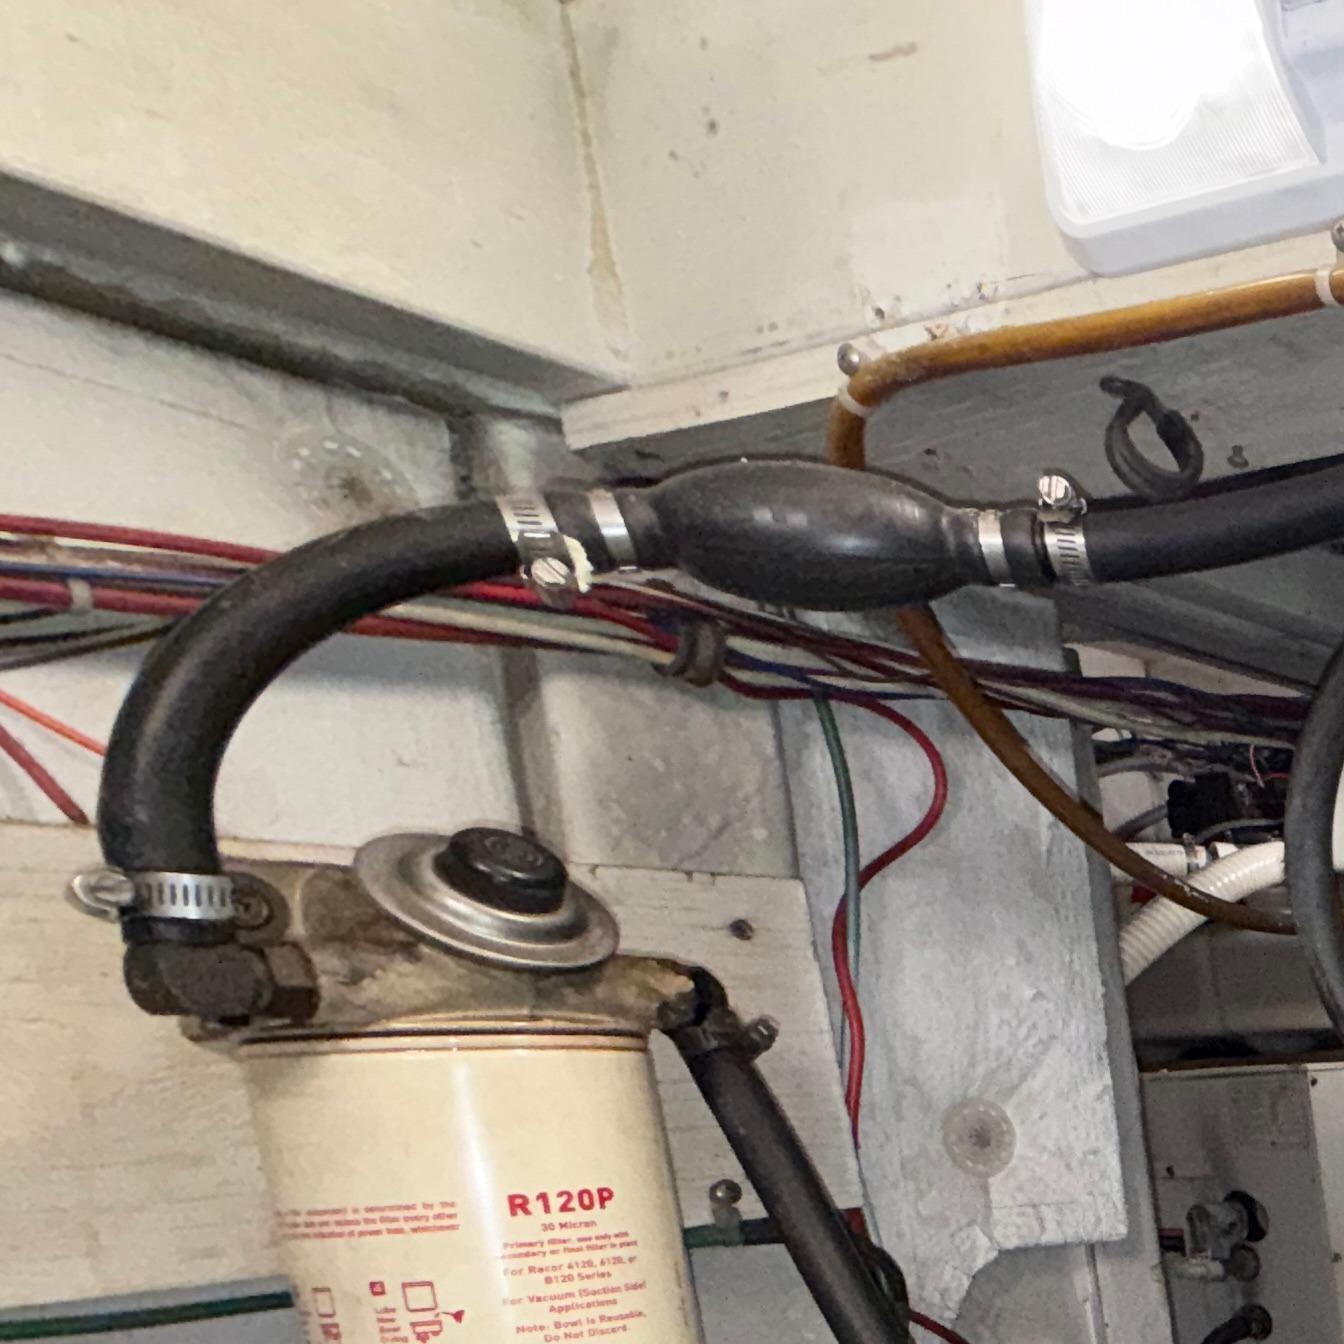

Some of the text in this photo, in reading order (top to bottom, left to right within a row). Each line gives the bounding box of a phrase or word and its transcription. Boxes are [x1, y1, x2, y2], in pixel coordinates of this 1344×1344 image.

[507, 1187, 614, 1217] R120P
[541, 1220, 597, 1232] 30 Micron
[528, 1263, 563, 1275] Racor
[577, 1270, 612, 1282] Series
[527, 1291, 575, 1303] Vacuum
[549, 1298, 618, 1313] Applications
[553, 1319, 583, 1330] Bowl
[544, 1332, 561, 1343] Do
[564, 1329, 585, 1341] Not
